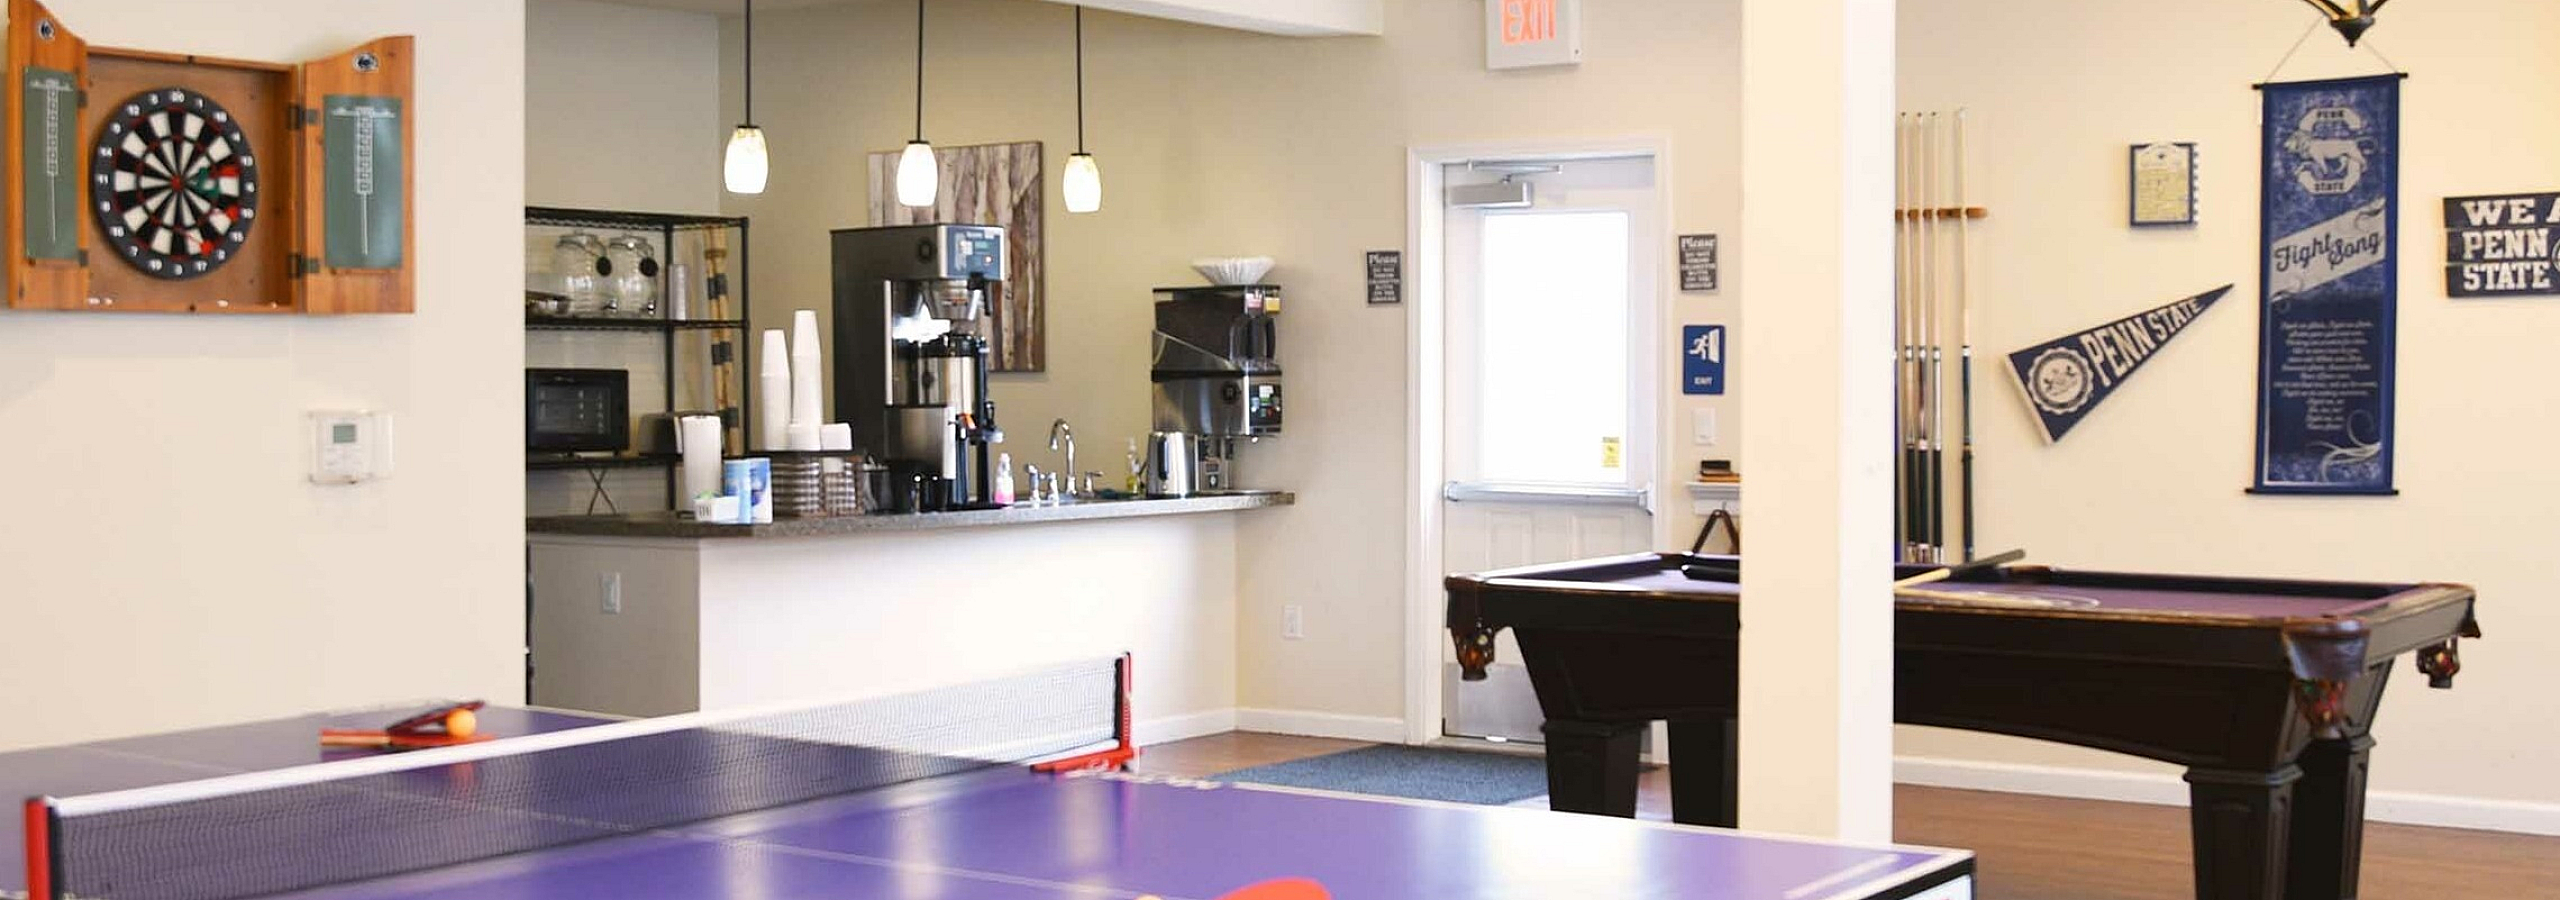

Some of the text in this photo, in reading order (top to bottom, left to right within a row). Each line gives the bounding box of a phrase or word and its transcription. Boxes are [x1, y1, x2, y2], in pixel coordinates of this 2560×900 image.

[2316, 109, 2344, 119] PENN
[2314, 181, 2345, 192] STATE
[2461, 198, 2535, 226] WE
[2274, 232, 2382, 272] Fight Song
[2462, 228, 2549, 260] PENN
[2463, 262, 2552, 291] STATE
[2079, 317, 2156, 388] PENN
[2146, 298, 2201, 342] STATE
